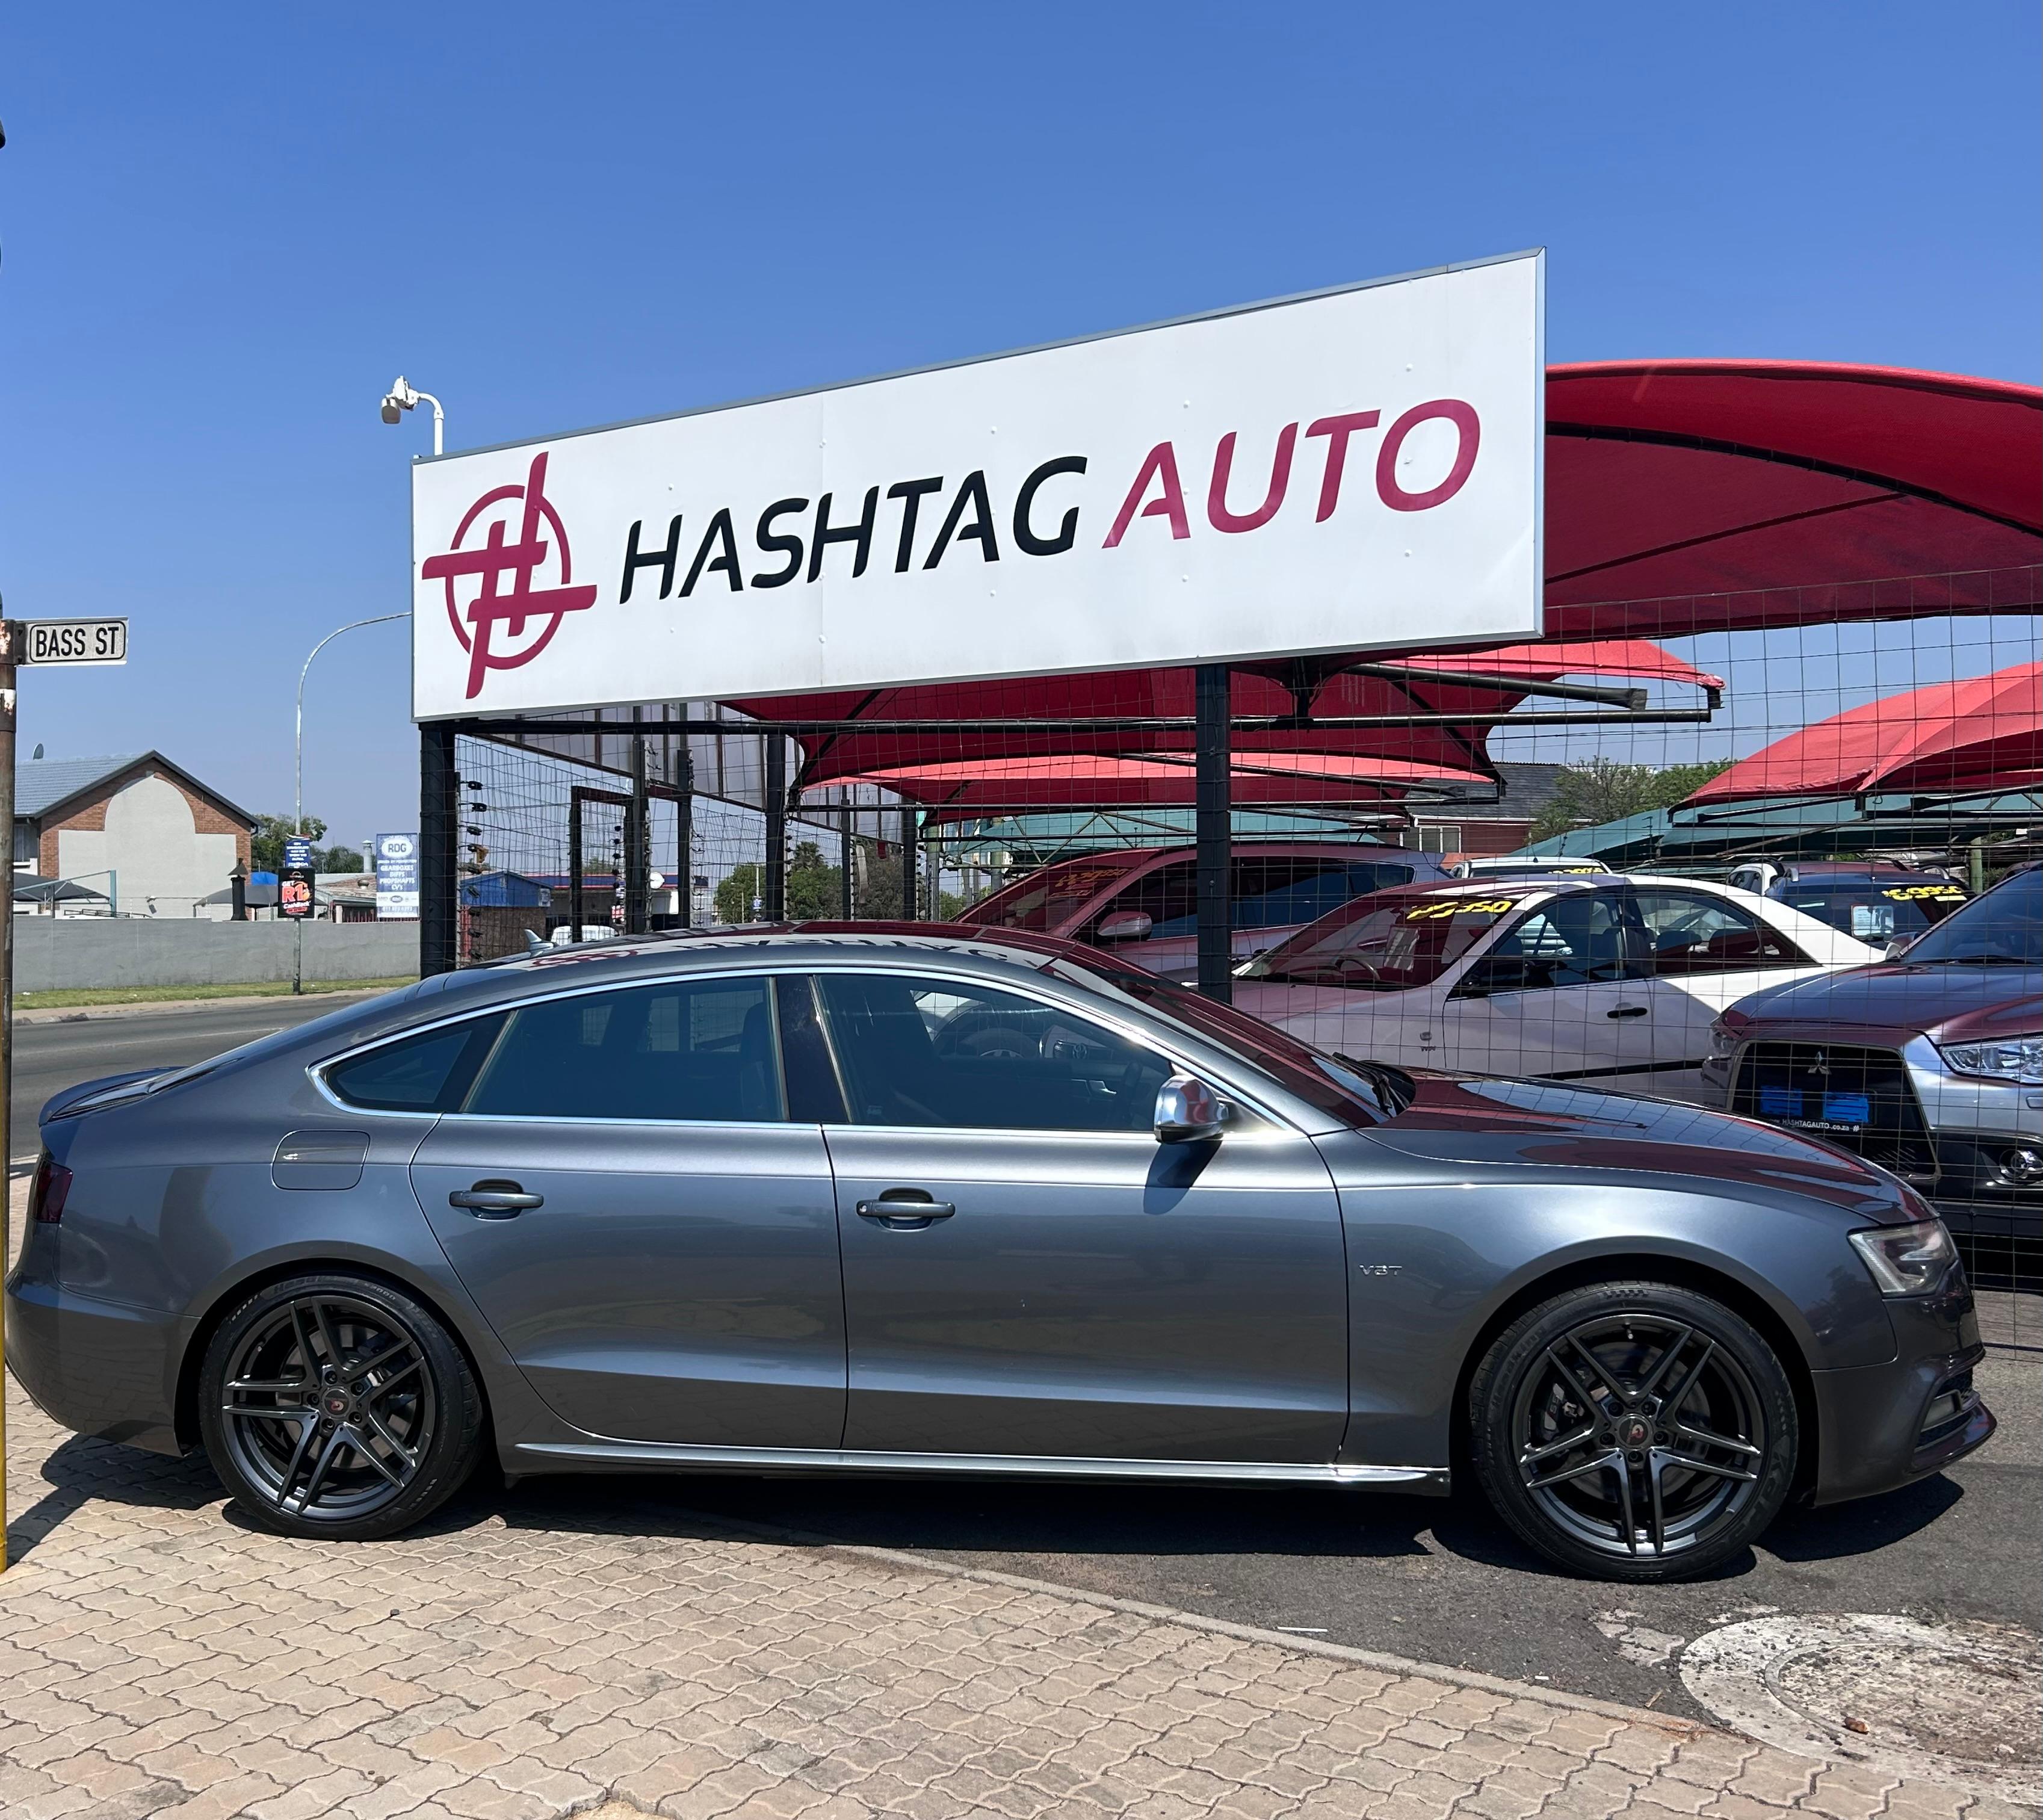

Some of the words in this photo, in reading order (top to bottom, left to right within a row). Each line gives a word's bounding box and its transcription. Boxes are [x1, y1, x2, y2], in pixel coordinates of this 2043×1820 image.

[620, 456, 1087, 604] HASHTAG
[1102, 398, 1481, 549] AUTO
[36, 628, 86, 657] BASS
[96, 627, 119, 655] ST
[388, 843, 407, 853] RDG
